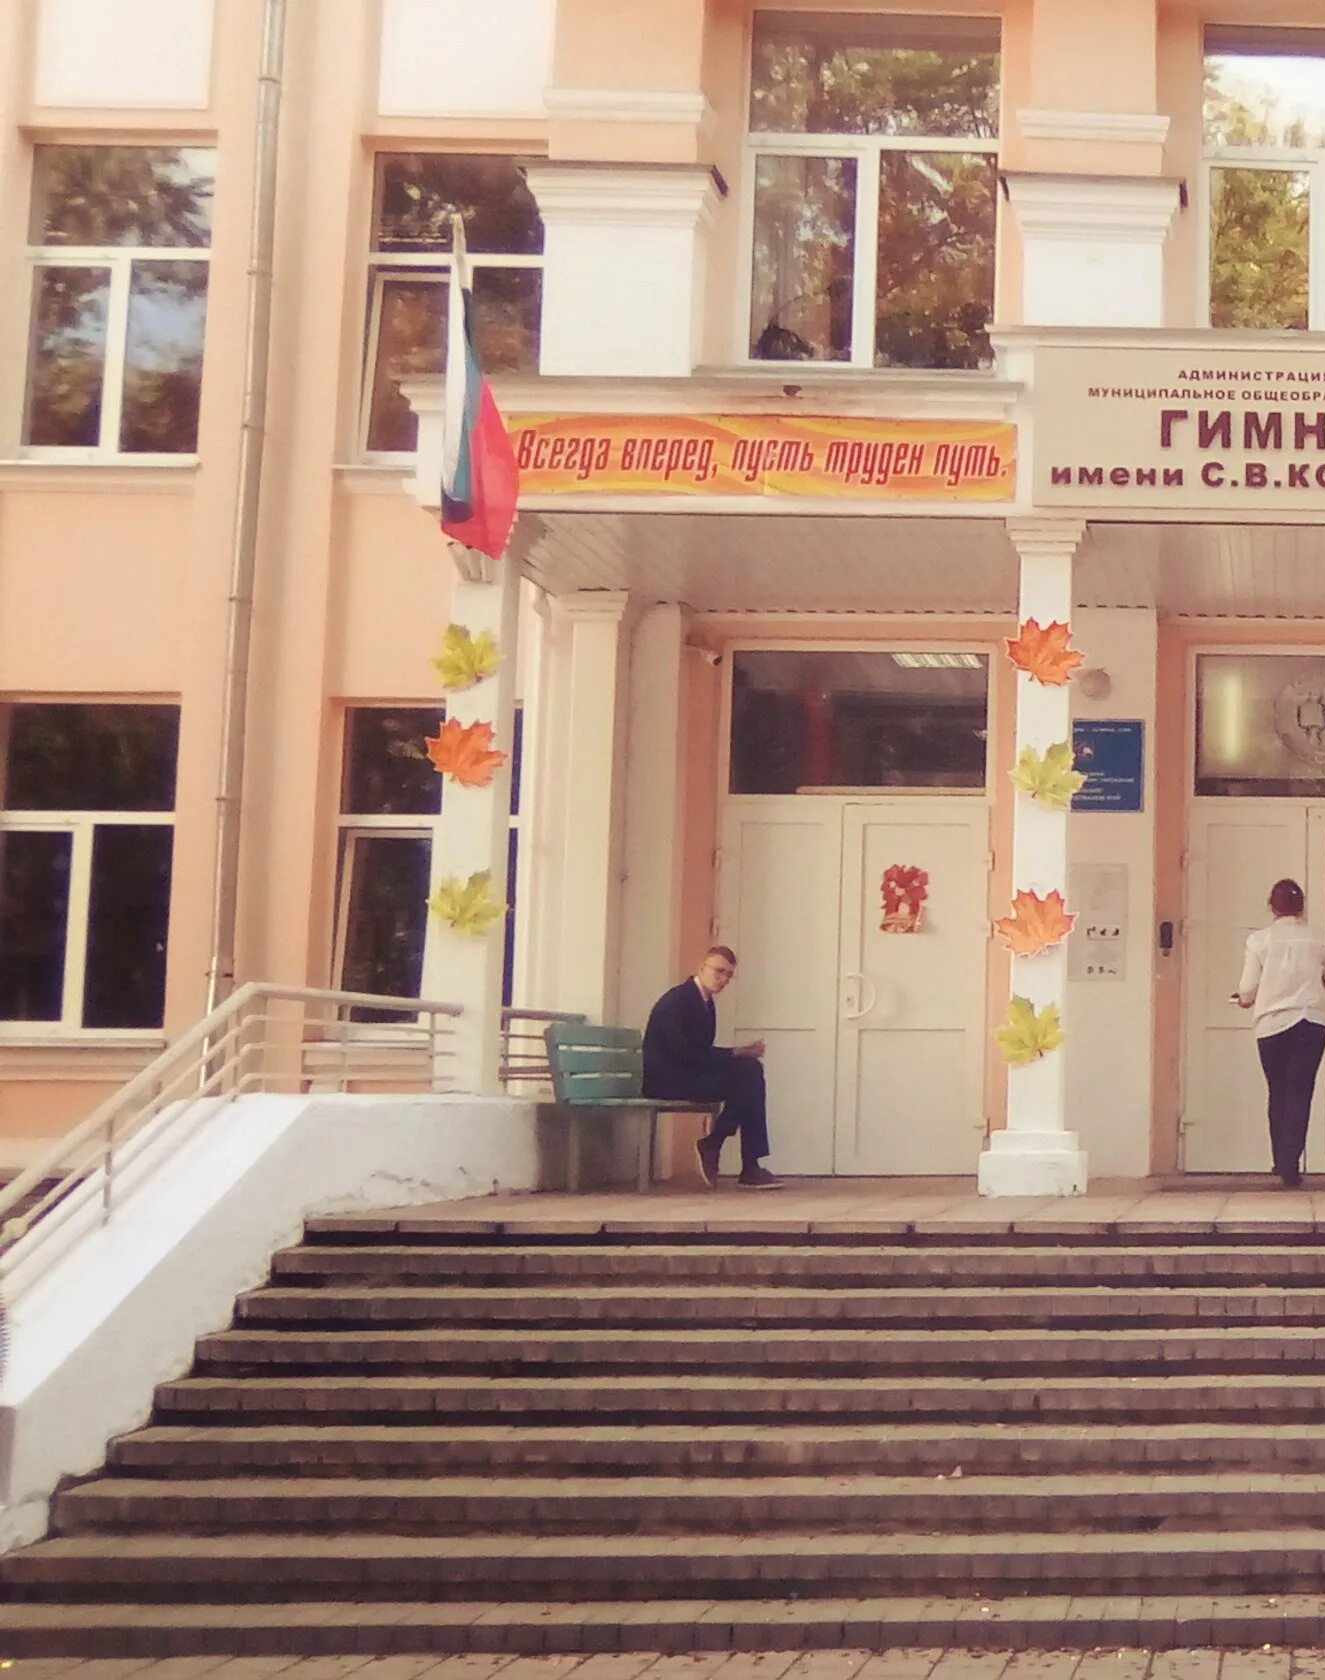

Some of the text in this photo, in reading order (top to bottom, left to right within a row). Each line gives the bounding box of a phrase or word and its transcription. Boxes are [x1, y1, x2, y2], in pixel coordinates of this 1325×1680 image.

[1088, 387, 1236, 400] МУНИЦИПАЛЬНОЕ
[517, 429, 1007, 486] Всегда вперед, пусть труден путь.
[1050, 464, 1185, 488] имени
